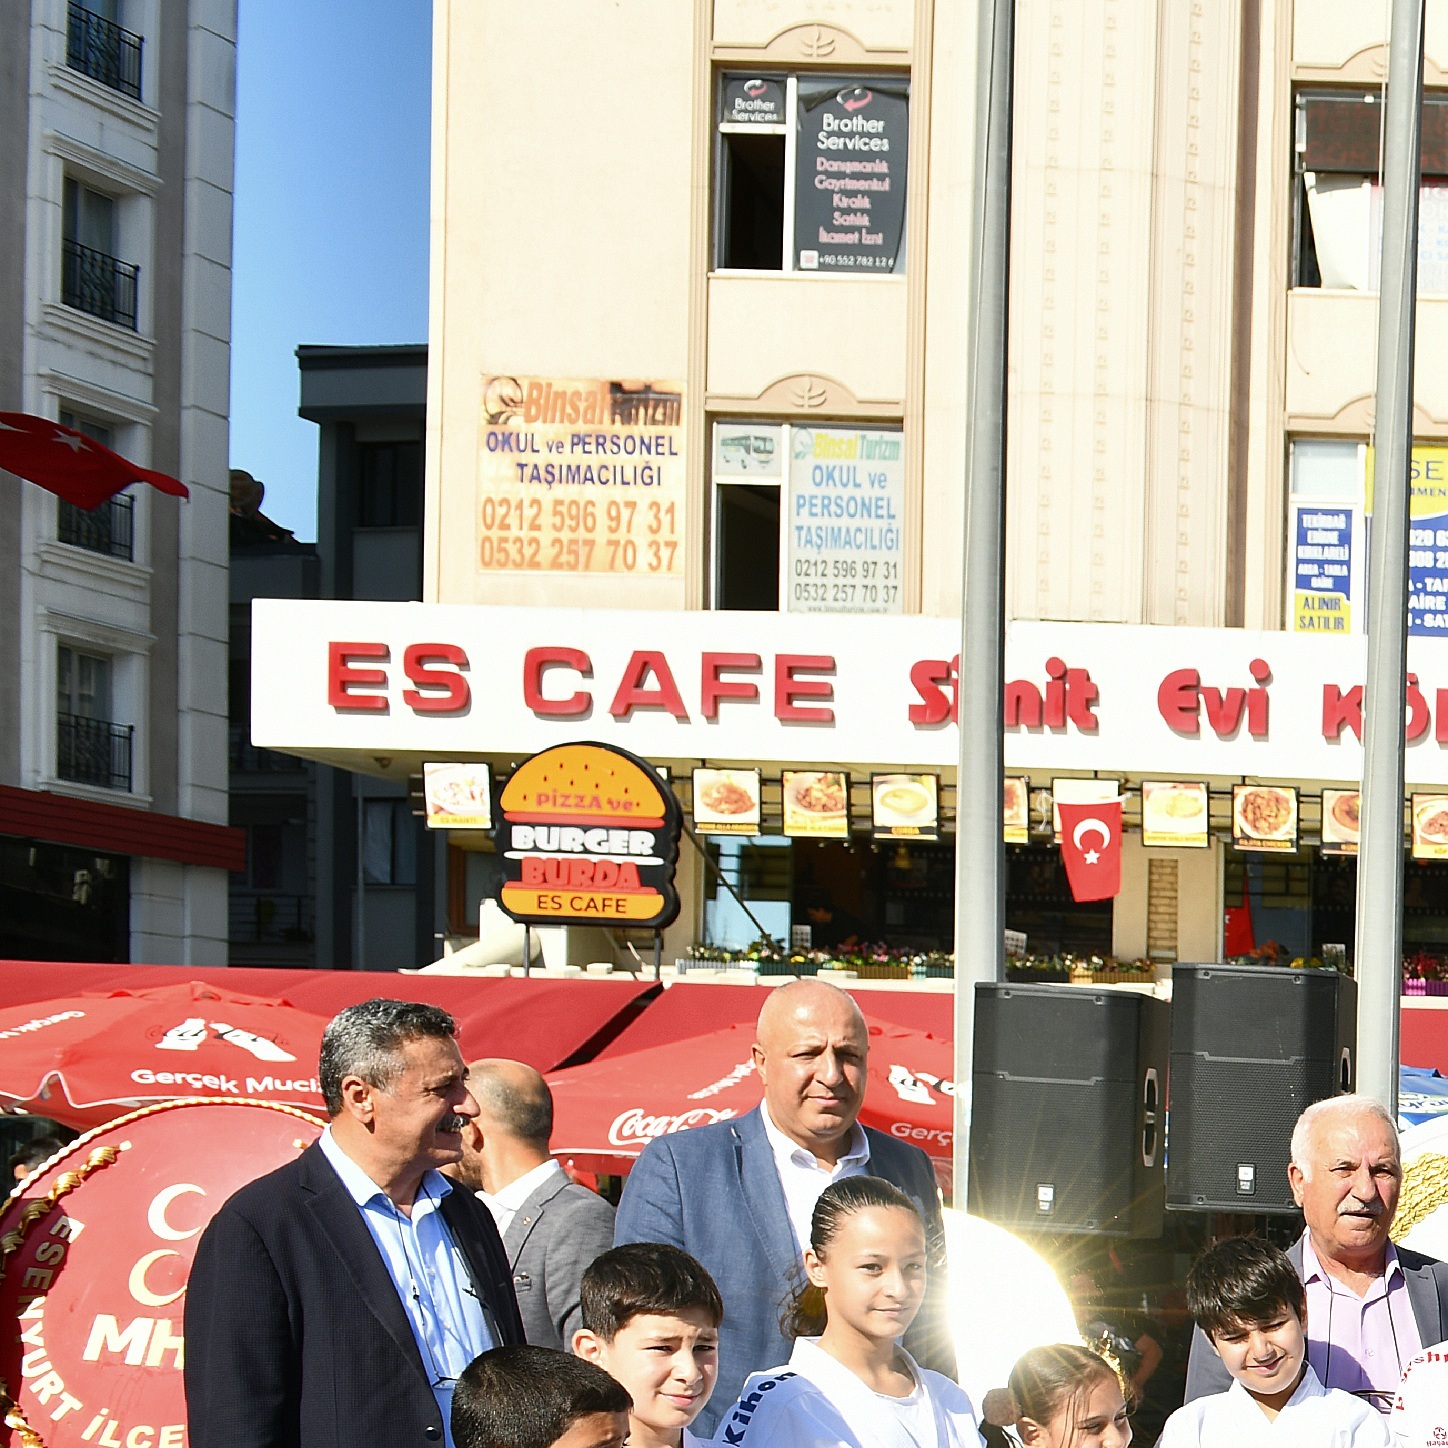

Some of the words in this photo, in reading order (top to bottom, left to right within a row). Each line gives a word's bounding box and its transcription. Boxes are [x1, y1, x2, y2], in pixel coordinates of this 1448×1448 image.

[735, 98, 775, 111] Brother
[823, 113, 884, 133] Brother
[817, 132, 889, 151] Services
[524, 381, 611, 425] Binsal
[486, 432, 540, 453] OKUL
[546, 440, 565, 454] ve
[571, 434, 678, 456] PERSONEL
[859, 434, 900, 461] Turizm
[516, 461, 661, 489] TAŞIMACILIĞI
[812, 464, 862, 488] OKUL
[869, 472, 887, 489] ve
[482, 497, 542, 532] 0212
[552, 500, 597, 533] 596
[606, 501, 637, 534] 97
[648, 501, 675, 535] 31
[796, 494, 896, 520] PERSONEL
[795, 524, 899, 554] TAŞIMACILIĞI
[480, 535, 541, 568] 0532
[550, 537, 596, 571] 257
[606, 540, 636, 571] 70
[648, 540, 678, 572] 37
[795, 559, 828, 577] 0212
[833, 560, 857, 578] 596
[862, 561, 878, 579] 97
[883, 562, 898, 580] 31
[795, 583, 828, 601] 0532
[832, 584, 857, 602] 257
[862, 585, 877, 602] 70
[883, 586, 898, 603] 37
[1409, 593, 1447, 610] AİRE
[1299, 616, 1345, 630] SATILIR
[328, 641, 470, 716] ES
[524, 646, 835, 722] CAFE
[1157, 658, 1274, 736] Evi
[536, 789, 602, 809] PİZZA
[607, 799, 634, 812] ve
[511, 825, 656, 856] BURGER
[521, 857, 643, 890] BURDA
[536, 895, 561, 911] ES
[572, 896, 628, 914] CAFE
[131, 1069, 239, 1094] Gerçek
[891, 1121, 954, 1146] Gerç
[17, 1214, 85, 1422] ESENYURT
[82, 1313, 185, 1370] MH
[722, 1371, 798, 1448] Kihon
